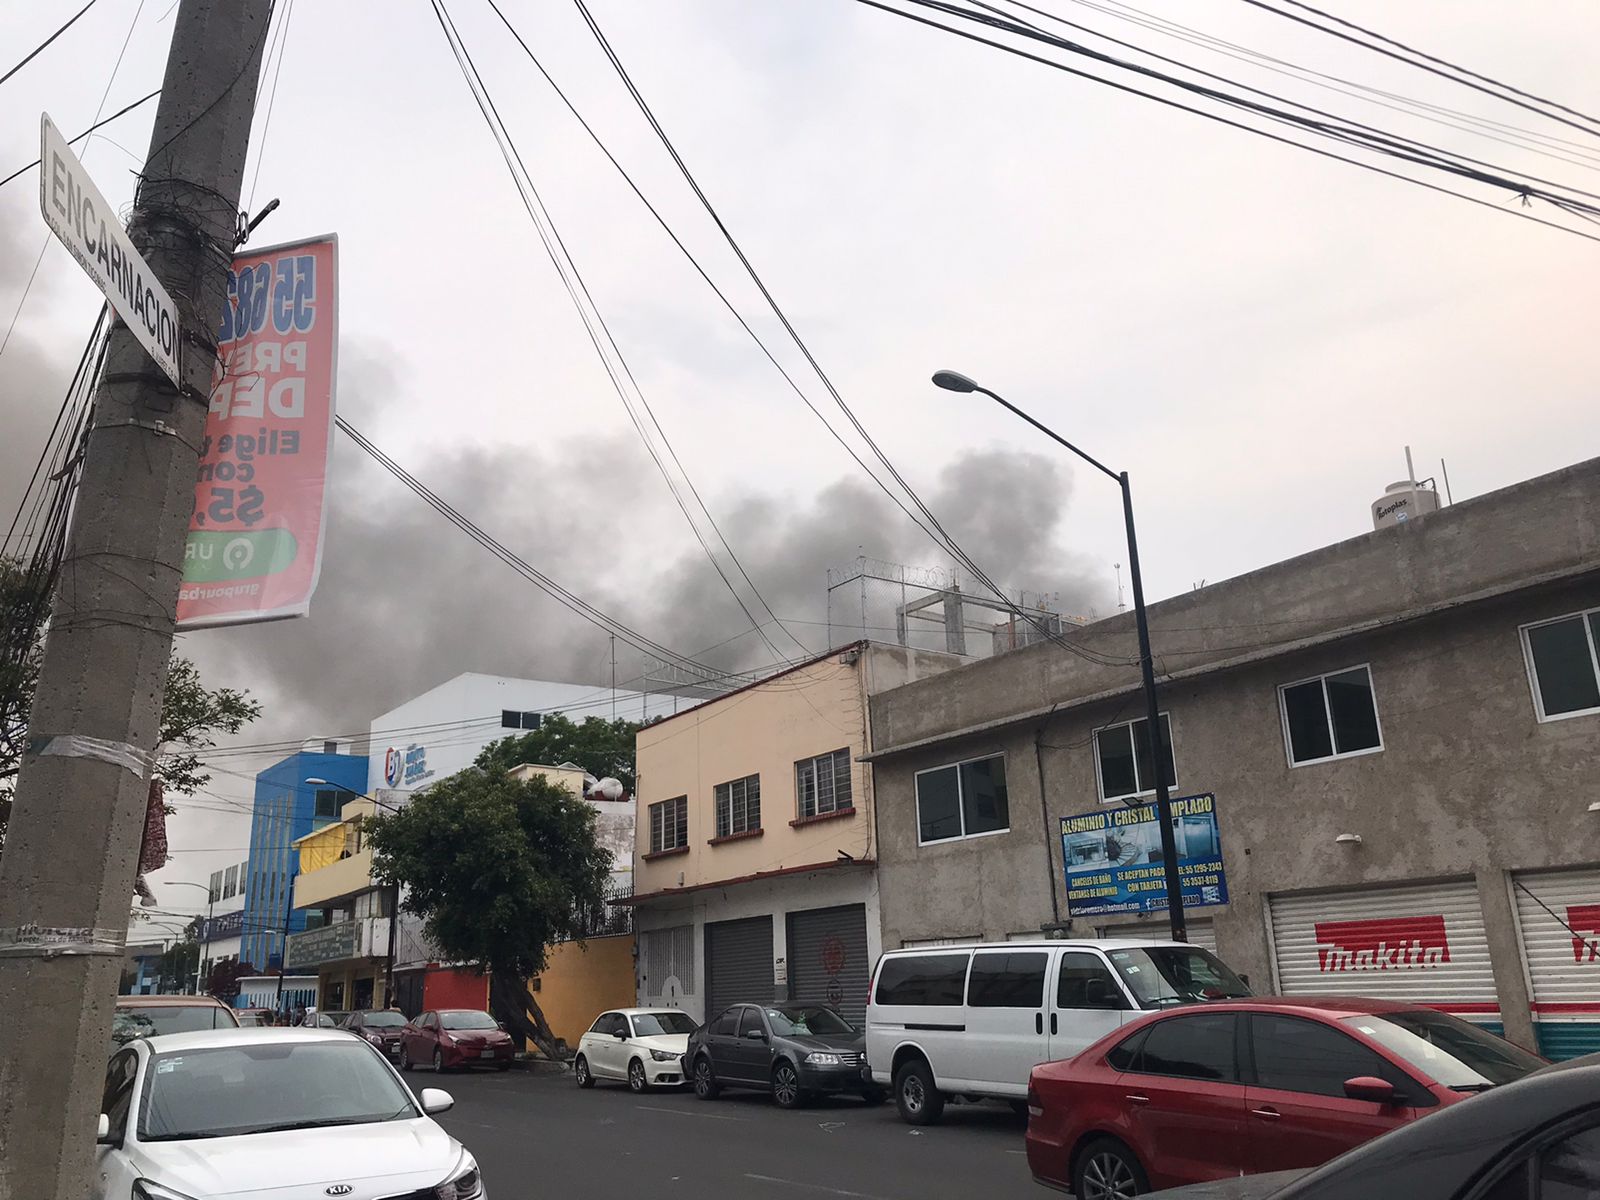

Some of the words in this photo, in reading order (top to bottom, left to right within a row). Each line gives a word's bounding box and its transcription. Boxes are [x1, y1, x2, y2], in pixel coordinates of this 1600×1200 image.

[52, 150, 181, 365] ENCARNACION
[1062, 816, 1105, 834] ALUMINIO
[1106, 812, 1113, 828] Y
[1114, 807, 1156, 826] CRISTAL
[1169, 796, 1212, 817] MPLADO
[1117, 871, 1125, 881] SE
[1125, 869, 1149, 880] ACEPTAN
[1150, 867, 1165, 877] PAGO
[1127, 881, 1139, 892] CON
[1140, 880, 1163, 891] TARJETA
[1316, 940, 1446, 971] makita
[330, 1185, 350, 1194] KIA
